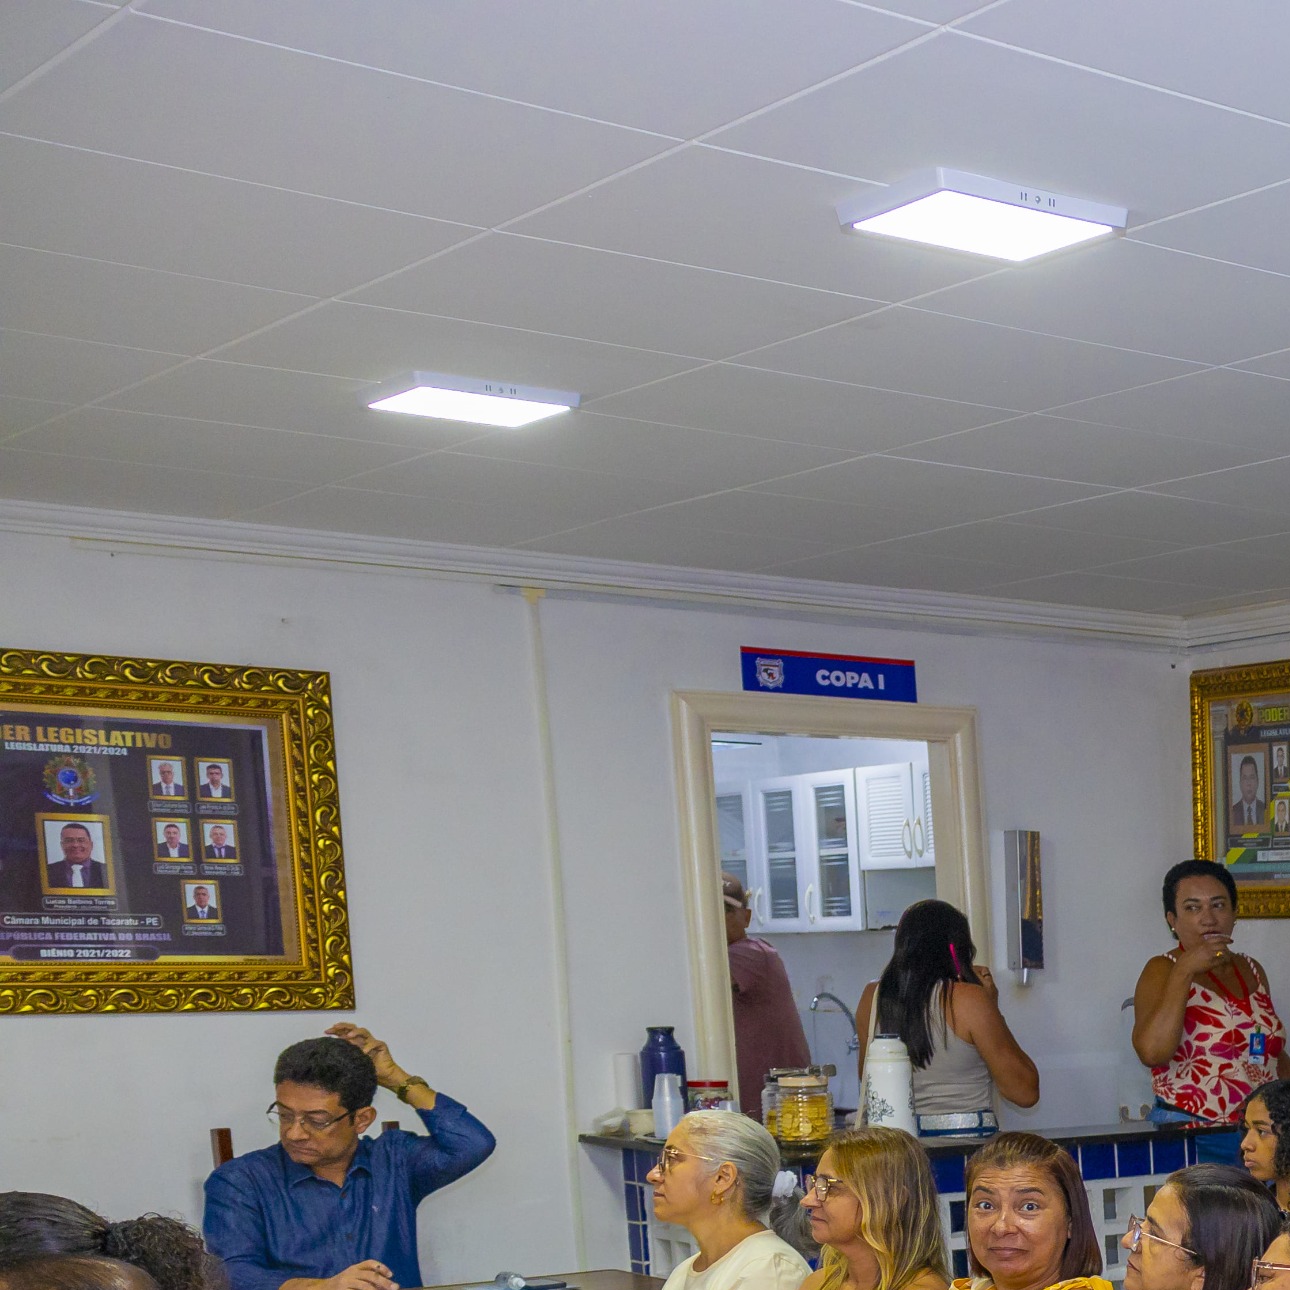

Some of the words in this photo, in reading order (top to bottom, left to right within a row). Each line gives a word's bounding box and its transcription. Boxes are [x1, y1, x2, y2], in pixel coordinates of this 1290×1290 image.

[816, 669, 874, 689] COPA
[36, 726, 172, 749] LEGISLATIVO
[3, 915, 39, 925] Câmara
[41, 916, 85, 926] Municipal
[87, 917, 99, 925] de
[101, 917, 139, 926] Tacaratu
[146, 917, 159, 926] PE
[0, 931, 53, 941] EPÚBLICA
